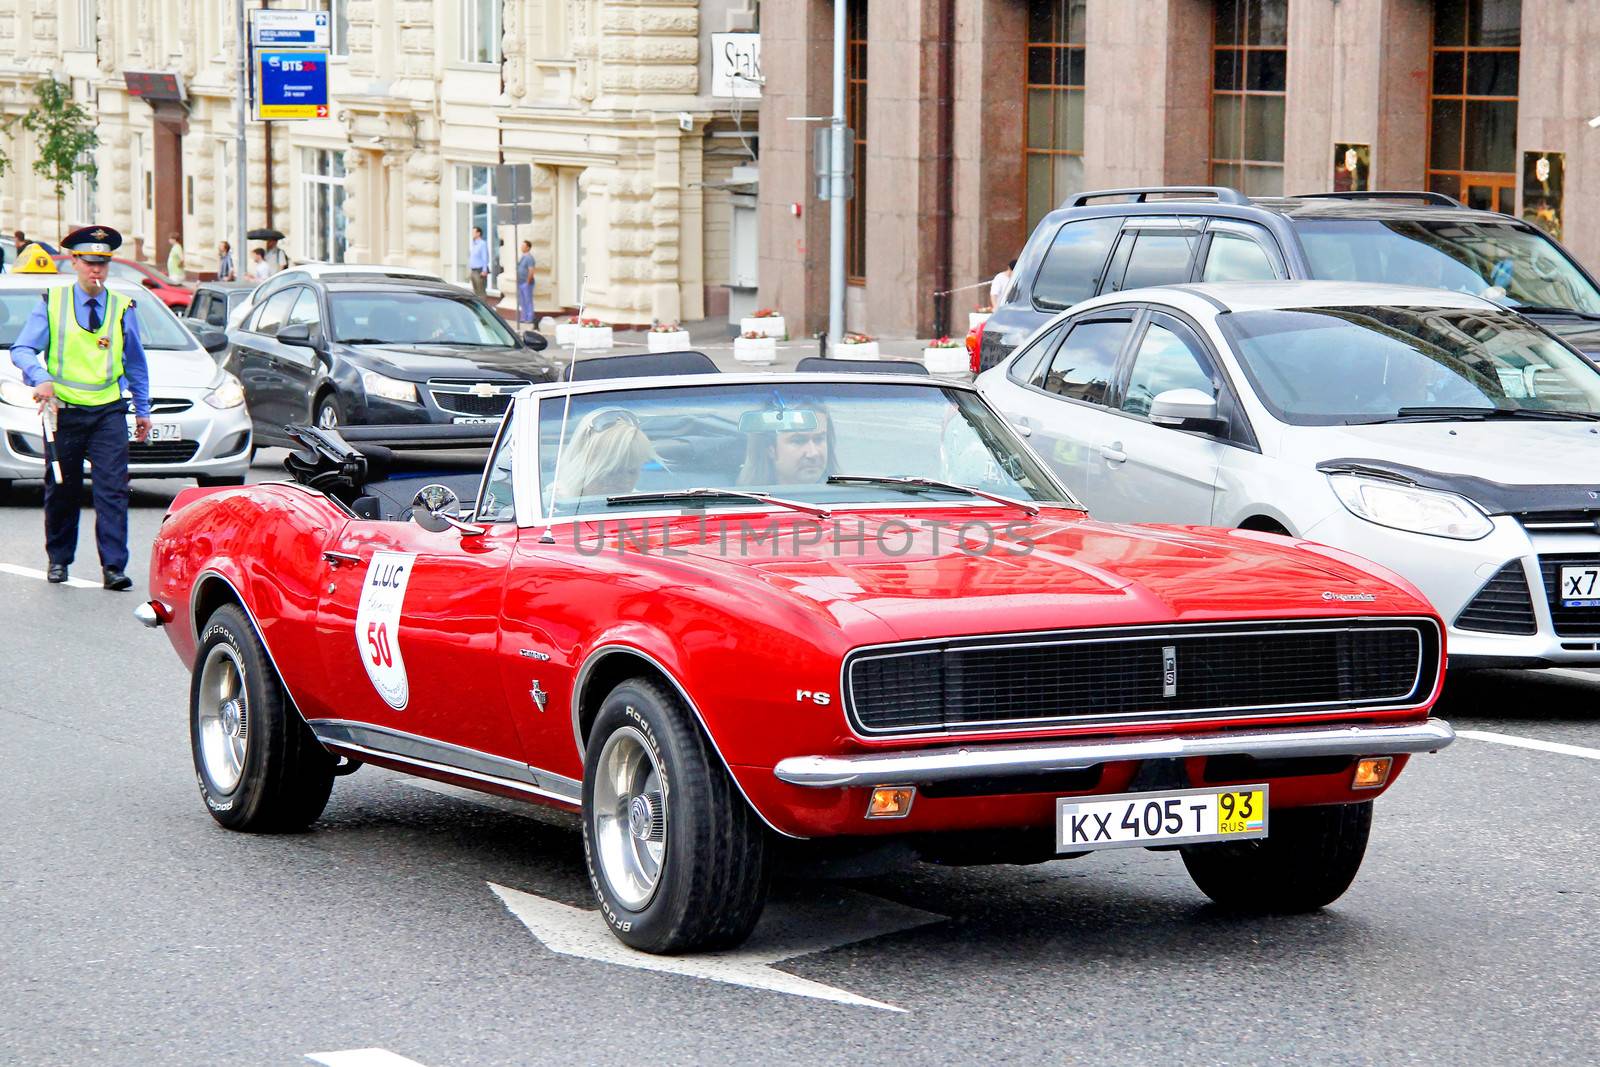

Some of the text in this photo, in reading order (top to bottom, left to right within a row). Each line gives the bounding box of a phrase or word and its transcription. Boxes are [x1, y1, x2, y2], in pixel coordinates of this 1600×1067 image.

[367, 622, 393, 669] 50
[625, 705, 661, 755] Radial
[1220, 792, 1253, 821] 93
[1220, 821, 1245, 832] RUS
